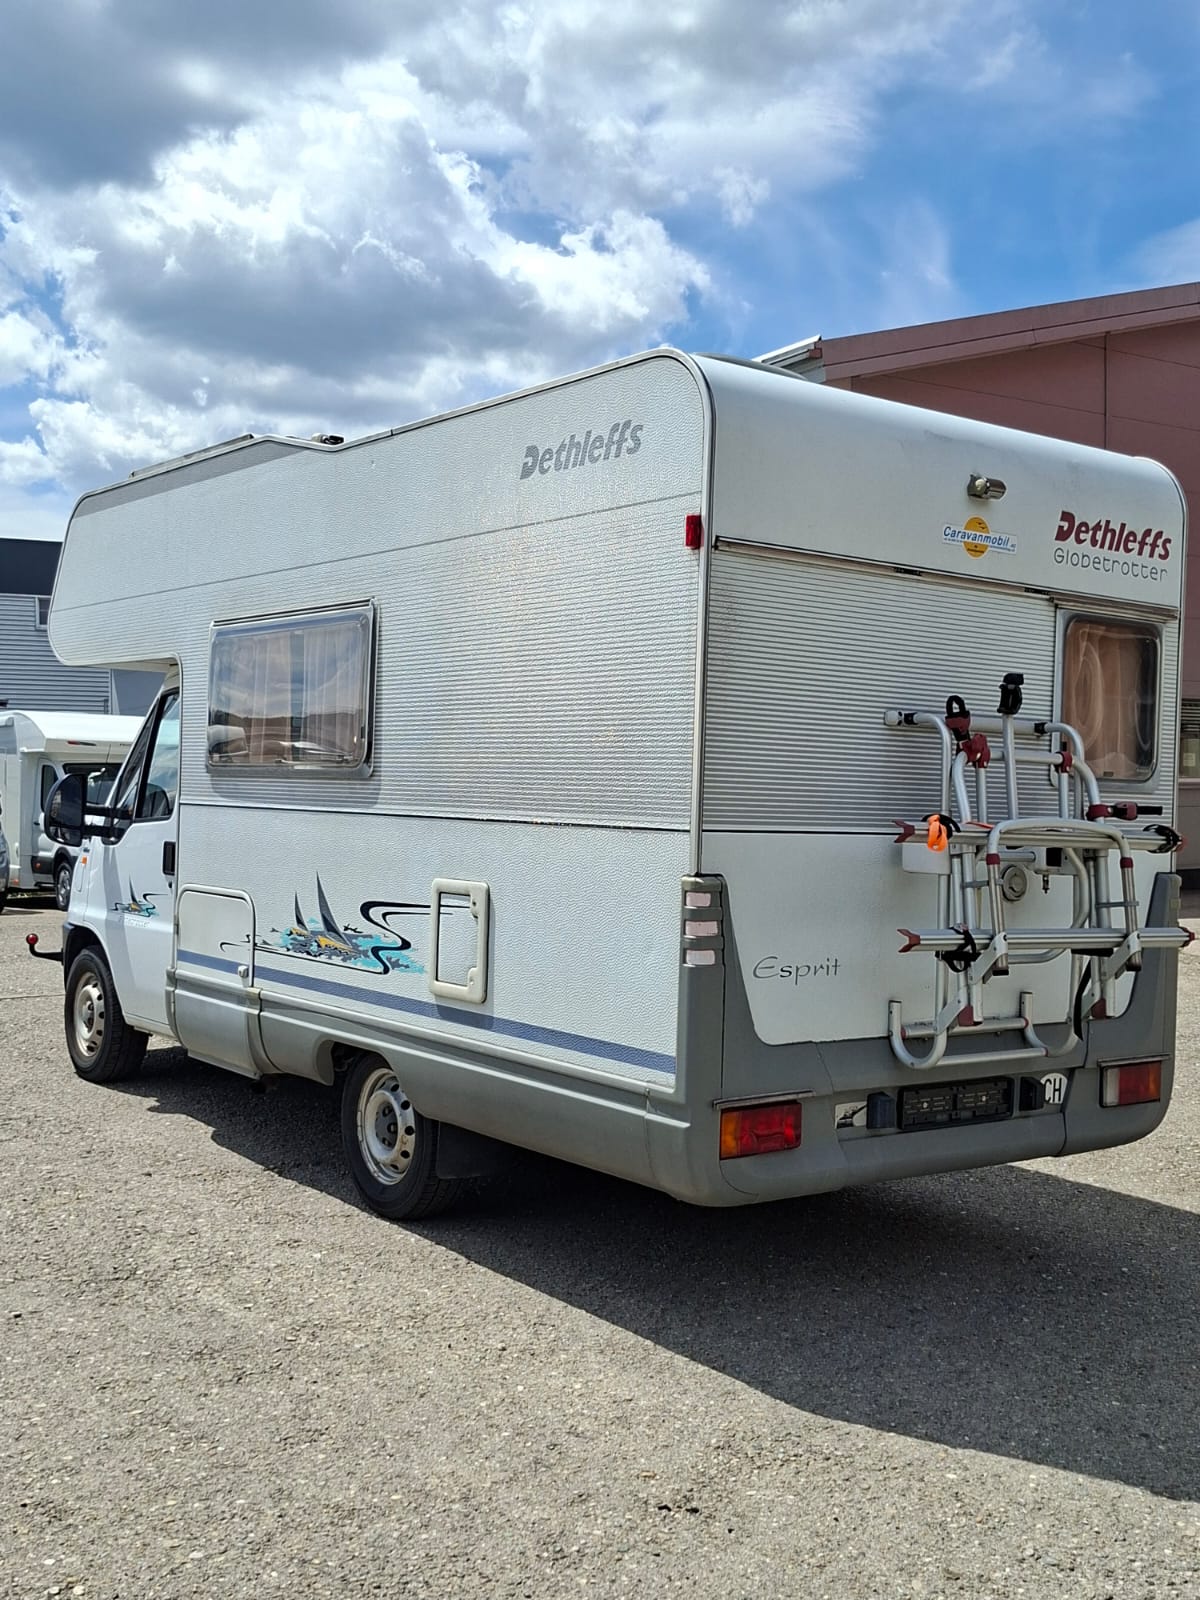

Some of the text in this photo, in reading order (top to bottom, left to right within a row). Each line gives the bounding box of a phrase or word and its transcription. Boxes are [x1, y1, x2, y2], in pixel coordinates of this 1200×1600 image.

[520, 419, 644, 480] Dethleffs
[943, 526, 1010, 547] Caravanmobil
[1054, 510, 1172, 561] Dethleffs
[1053, 547, 1168, 582] Globetrotter
[753, 956, 841, 986] Esprit
[1043, 1077, 1063, 1104] CH
